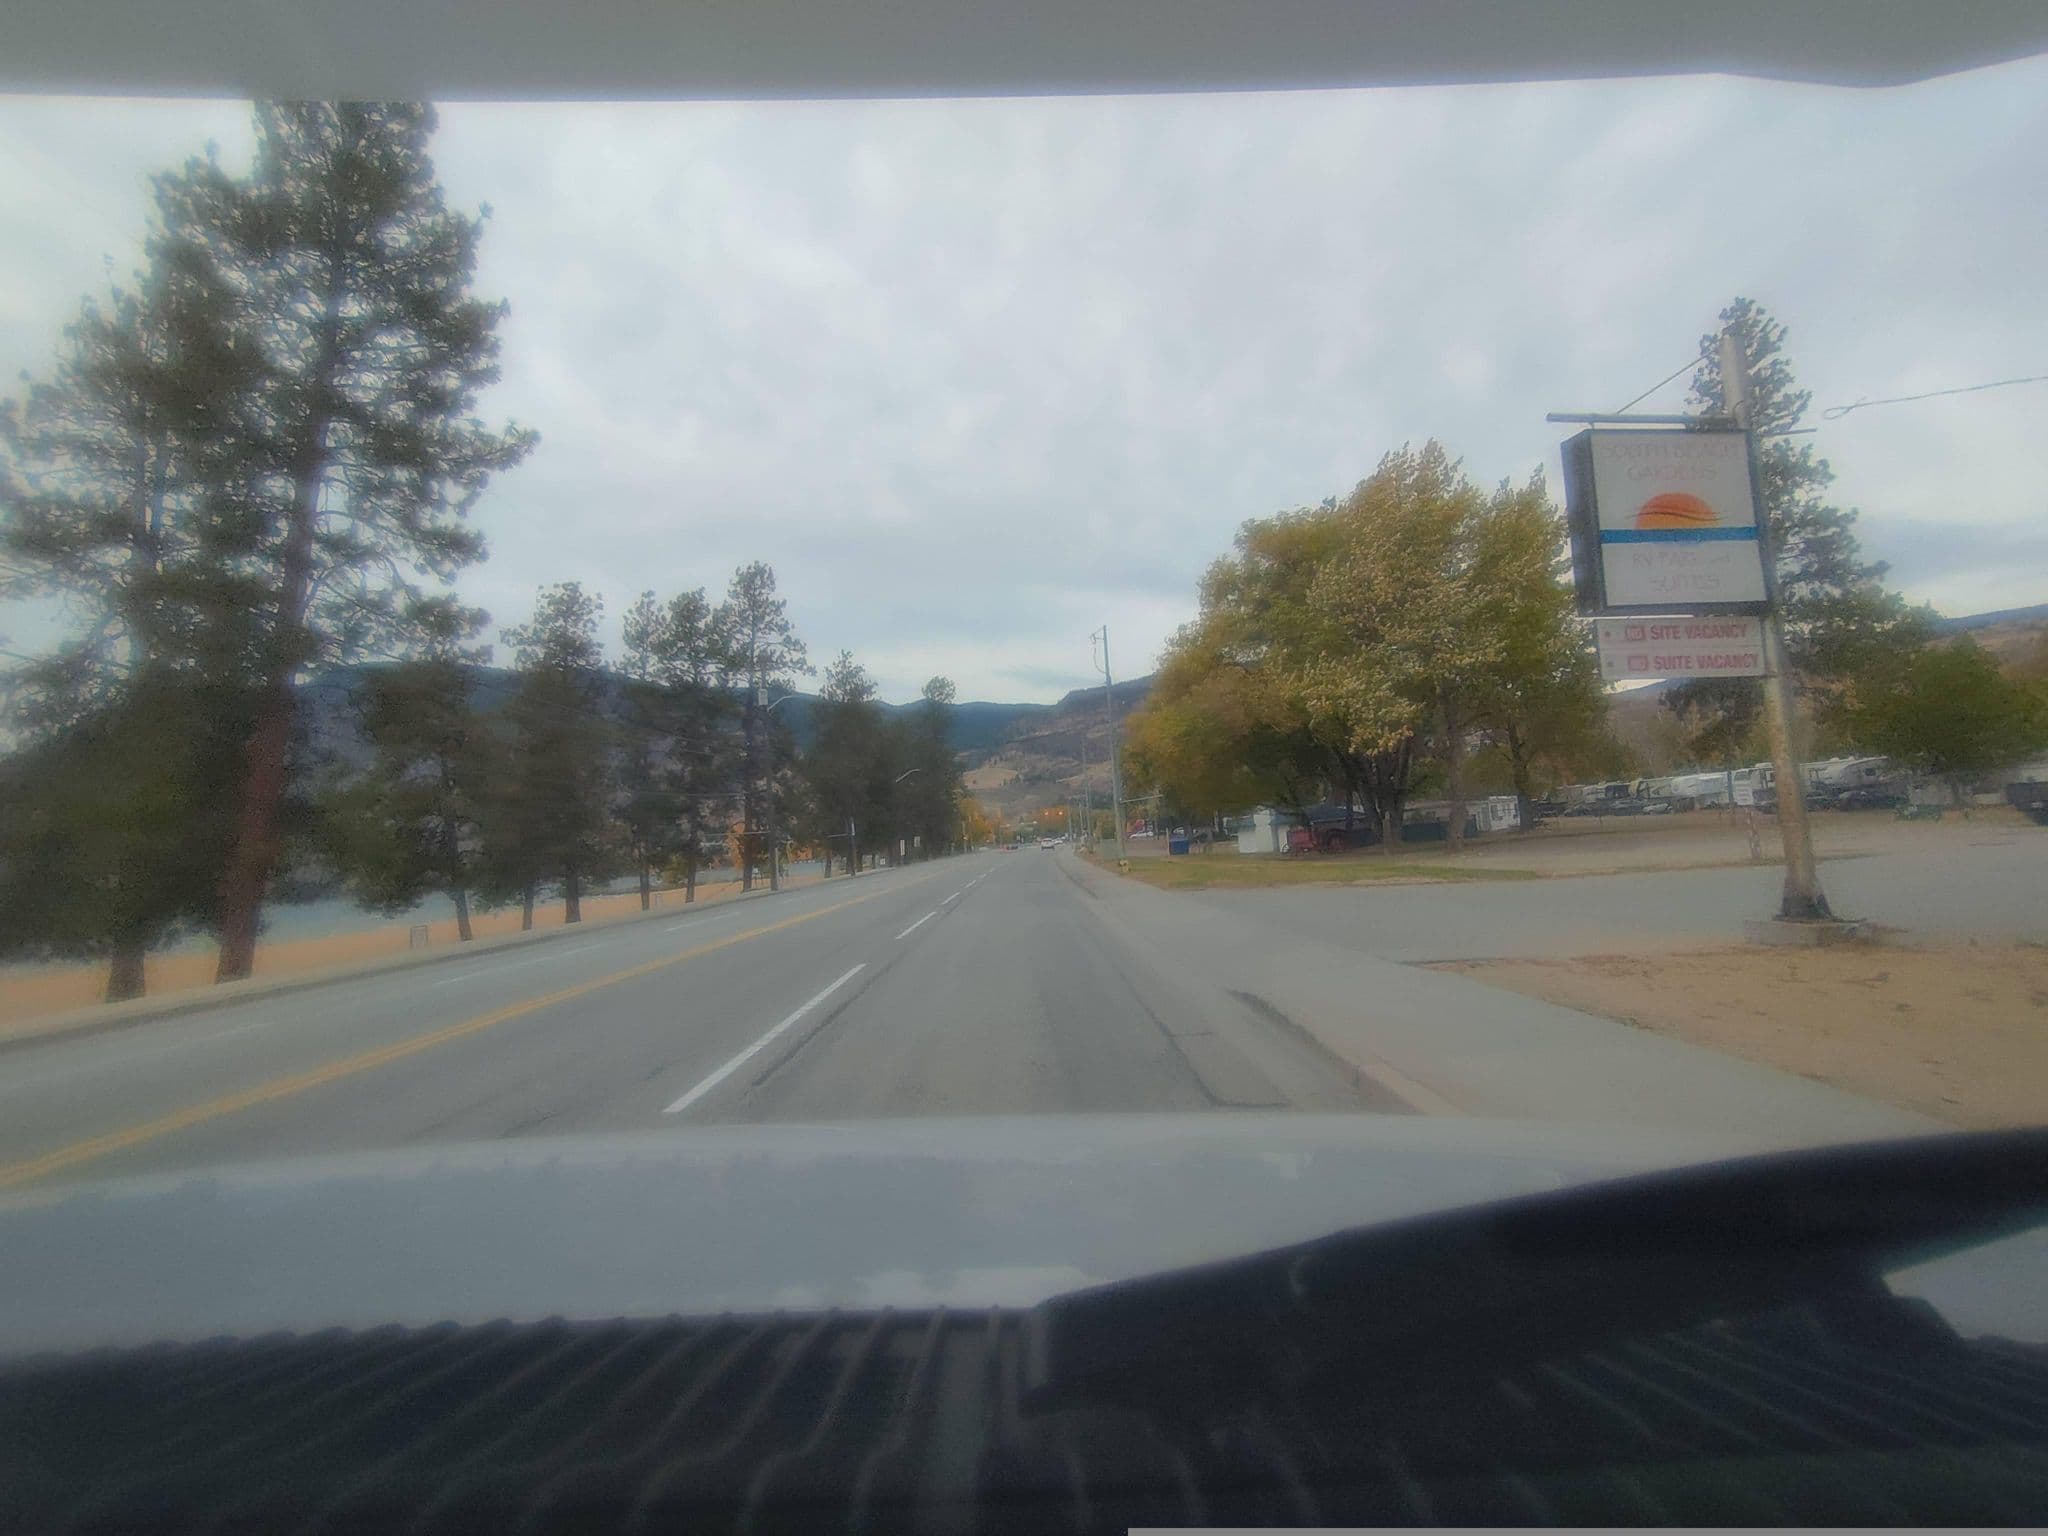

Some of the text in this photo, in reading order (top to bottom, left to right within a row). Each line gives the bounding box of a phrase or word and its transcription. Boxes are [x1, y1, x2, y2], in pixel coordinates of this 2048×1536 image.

[1650, 623, 1748, 640] SITE VACANCY
[1653, 653, 1759, 670] SUITE VACANCY
